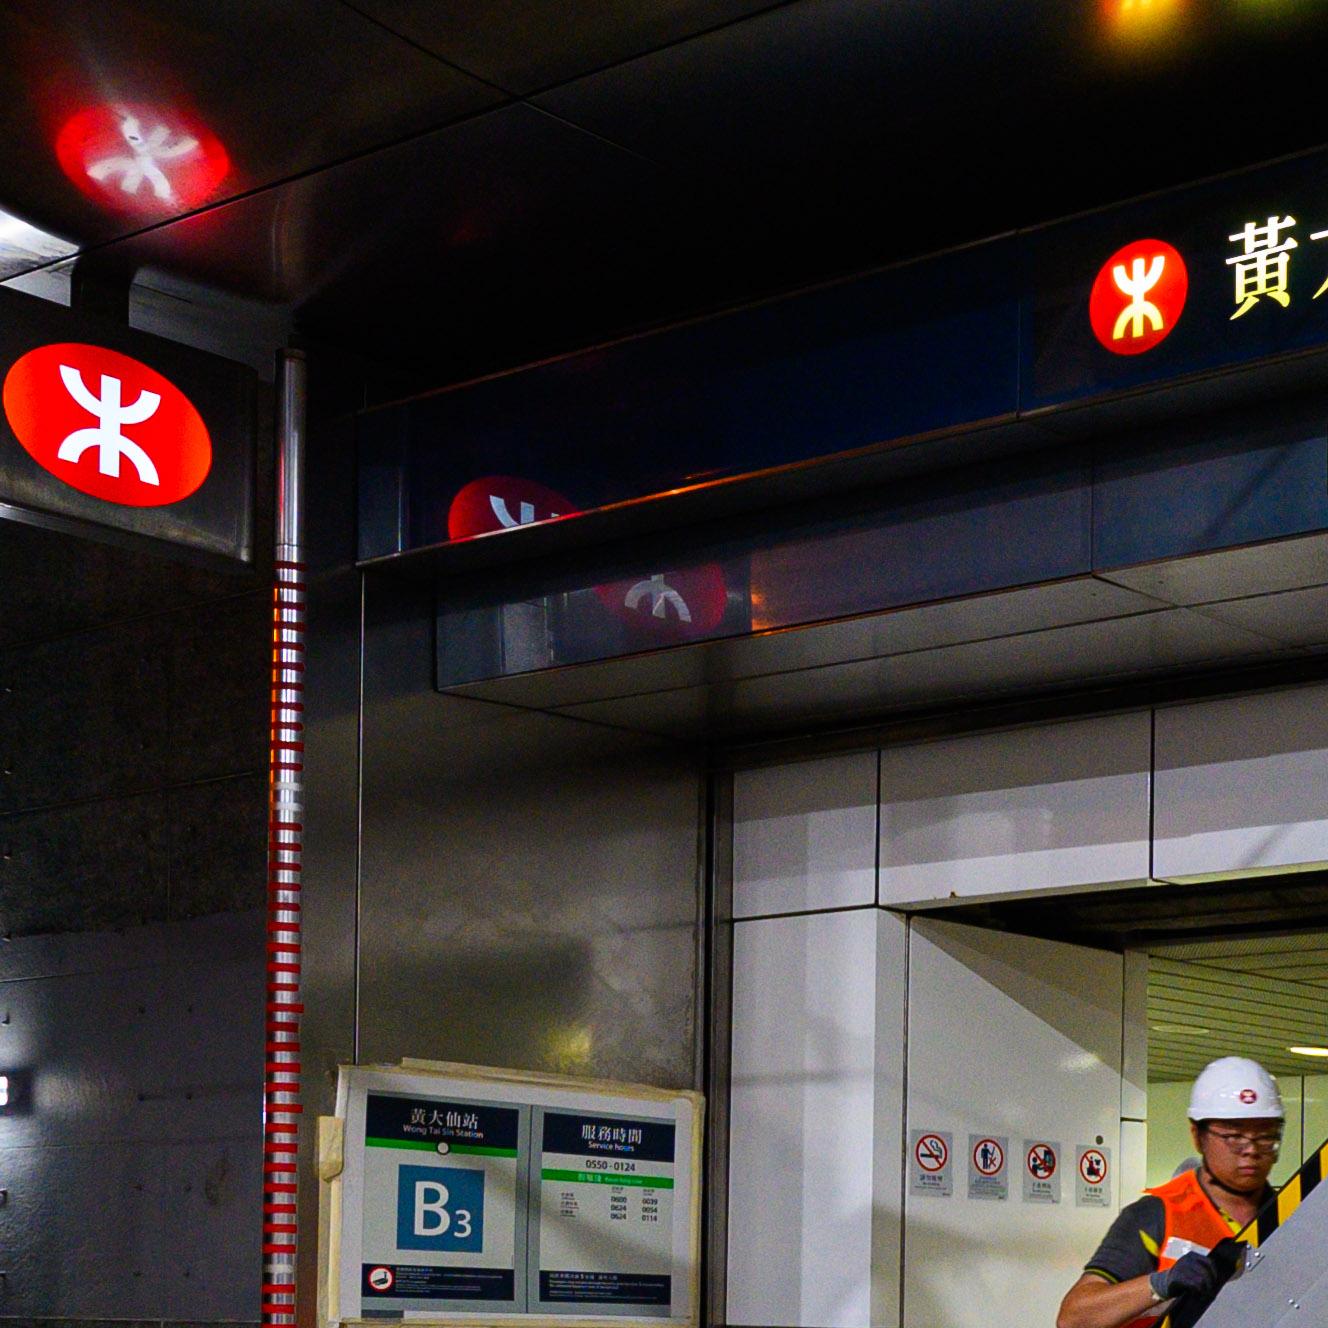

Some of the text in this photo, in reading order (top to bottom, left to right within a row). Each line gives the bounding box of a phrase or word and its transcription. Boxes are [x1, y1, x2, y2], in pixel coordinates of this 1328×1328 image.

[403, 1124, 484, 1139] Wong Tai Sin Station
[581, 1124, 642, 1145] 服務時間
[588, 1140, 613, 1151] Service
[585, 1159, 608, 1170] 0550
[613, 1161, 636, 1172] 0124
[414, 1181, 472, 1238] B3
